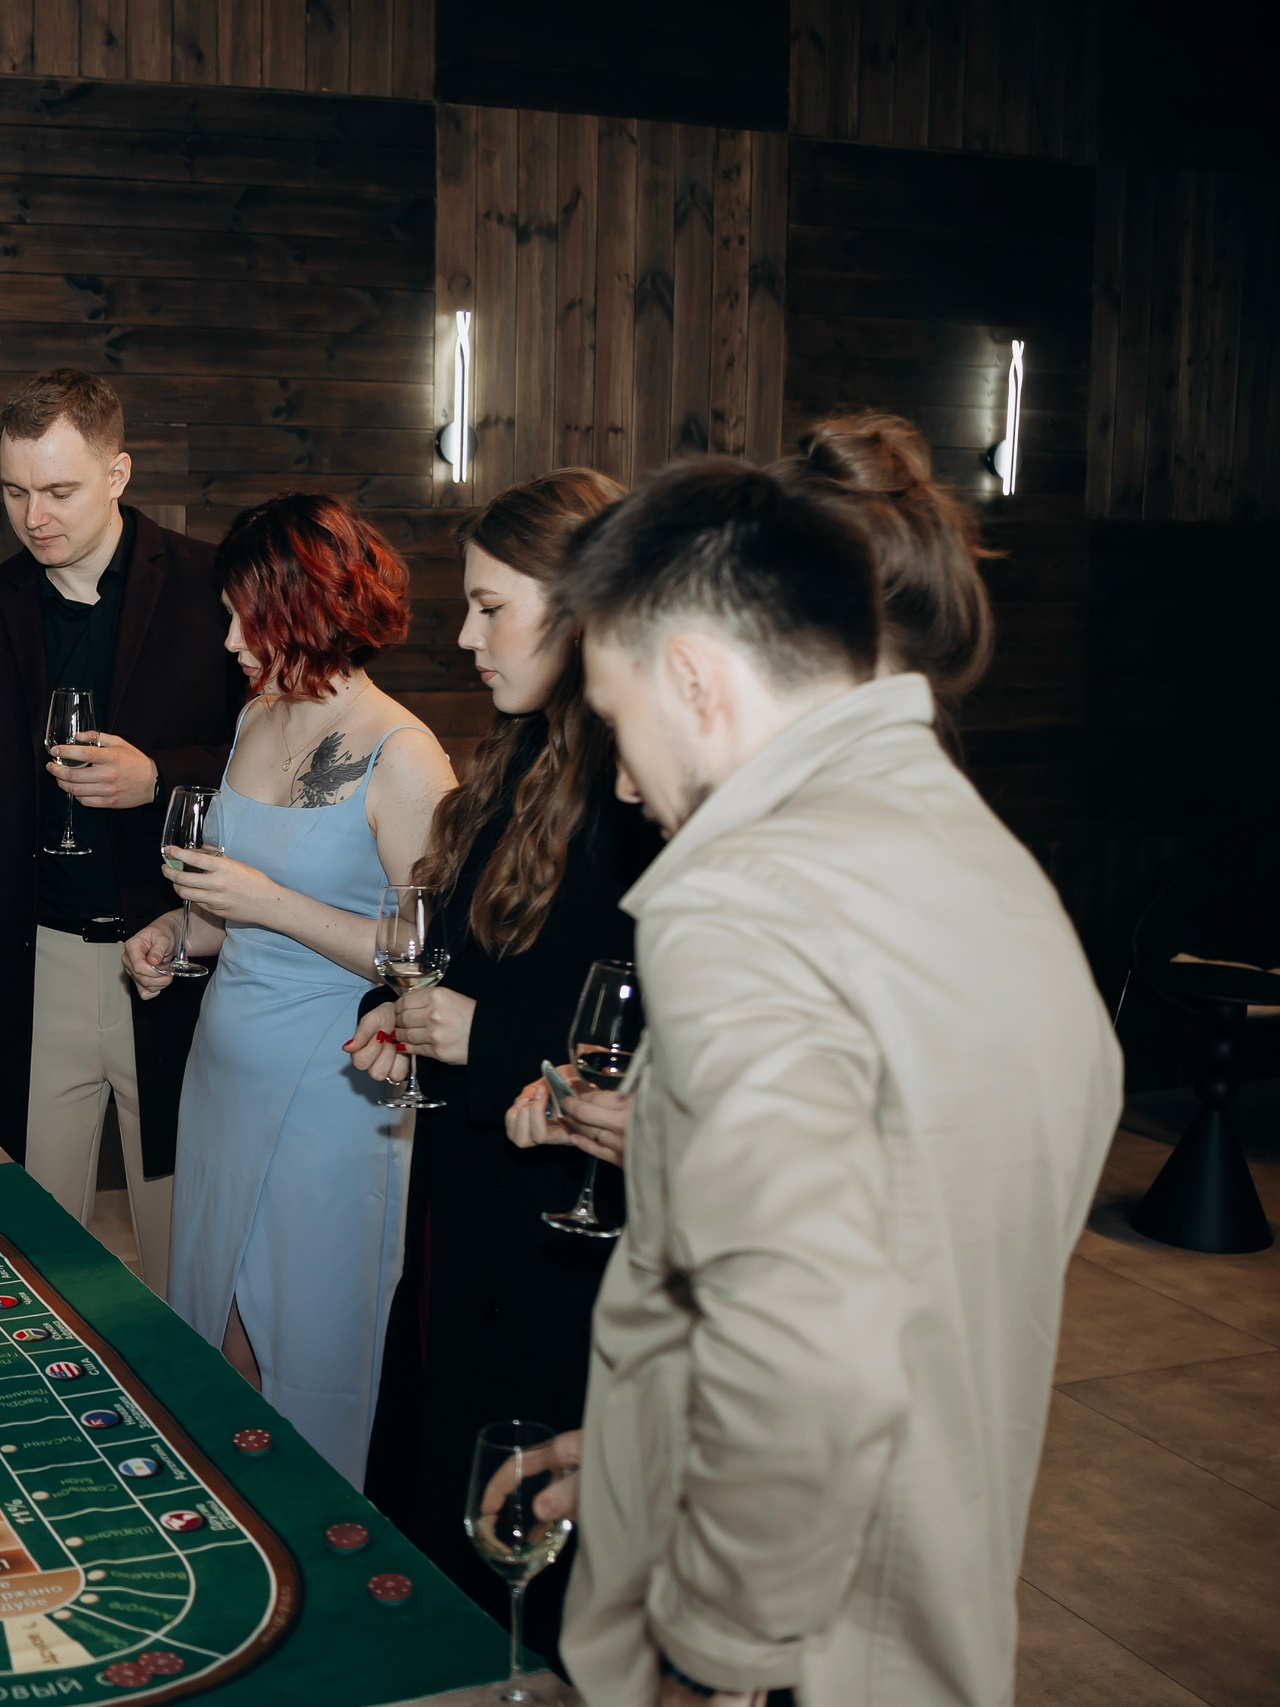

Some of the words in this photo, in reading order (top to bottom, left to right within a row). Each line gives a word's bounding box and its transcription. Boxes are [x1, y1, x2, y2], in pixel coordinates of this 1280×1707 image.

[80, 1357, 100, 1376] США
[113, 1403, 137, 1426] Новая
[118, 1395, 152, 1429] Зеландия
[22, 1435, 83, 1449] Рислинг
[150, 1443, 188, 1481] Аргентина
[3, 1498, 35, 1525] 11%
[83, 1525, 154, 1542] Шардоне
[1, 1598, 48, 1613] дубе
